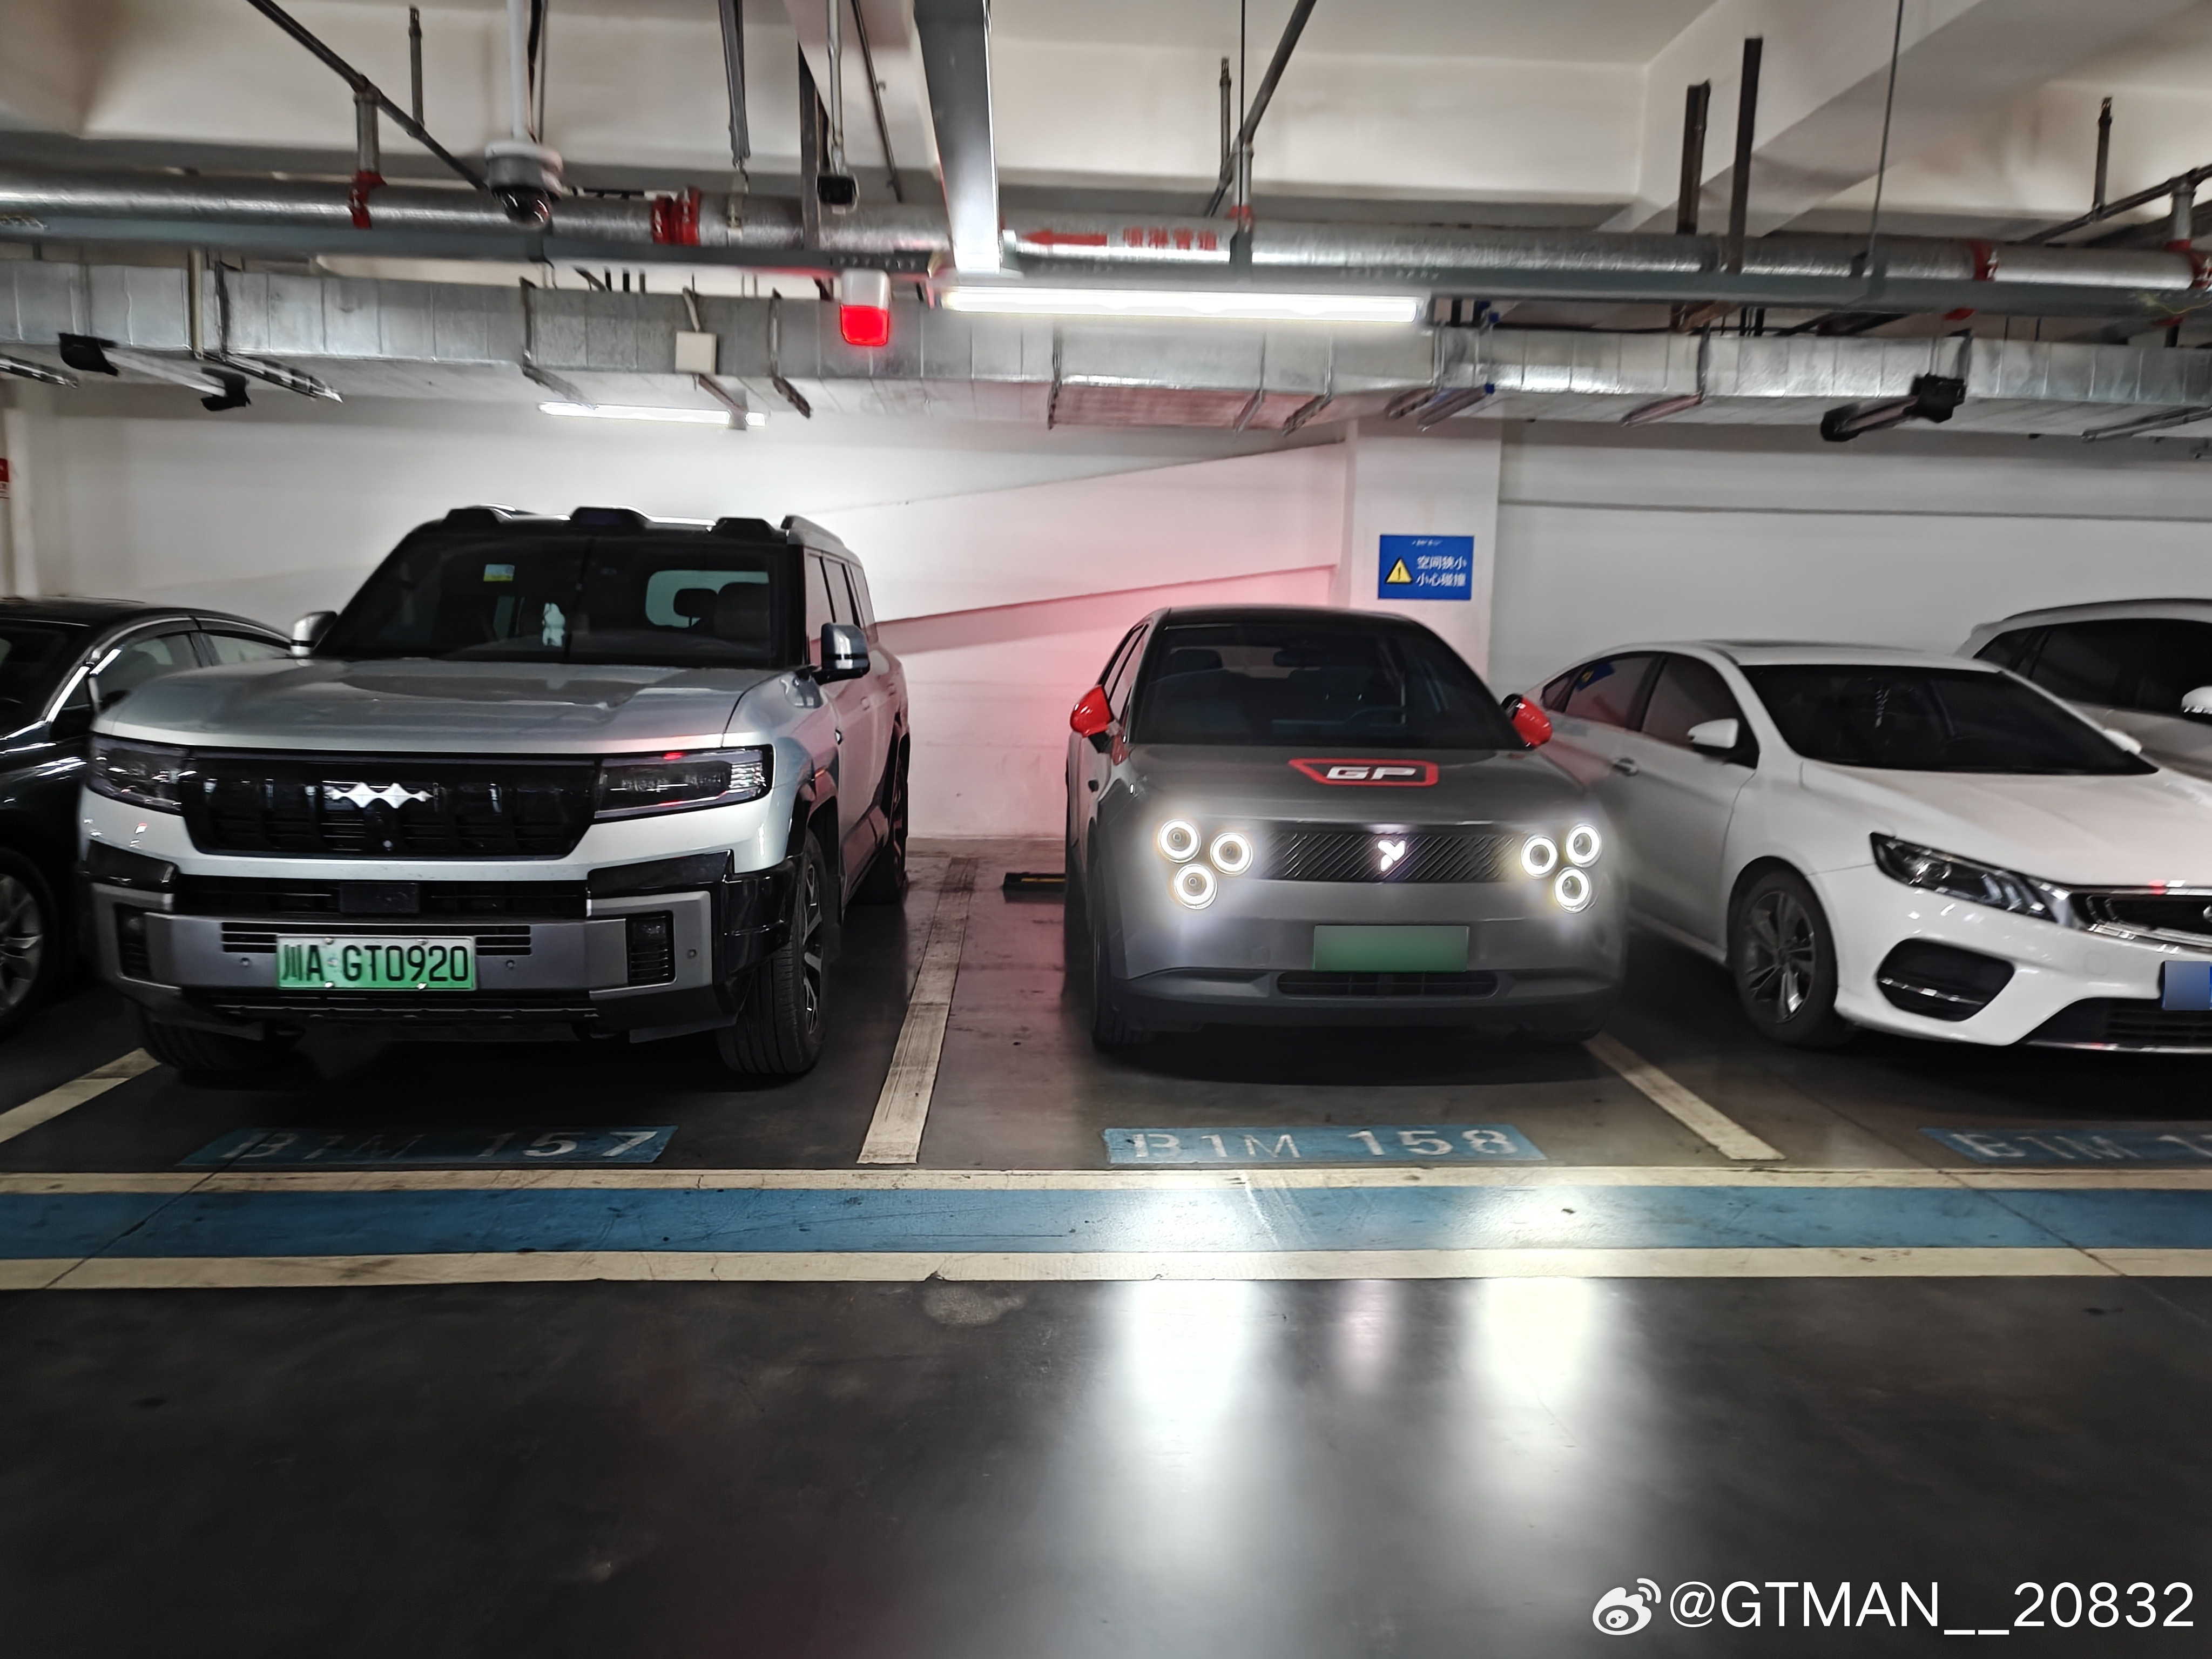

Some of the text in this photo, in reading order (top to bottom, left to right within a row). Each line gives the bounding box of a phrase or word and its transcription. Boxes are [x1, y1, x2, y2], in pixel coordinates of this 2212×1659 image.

[1326, 766, 1416, 780] GP
[477, 1131, 658, 1157] 157
[1131, 1129, 1518, 1158] B1M 158
[1950, 1134, 2143, 1159] B1M
